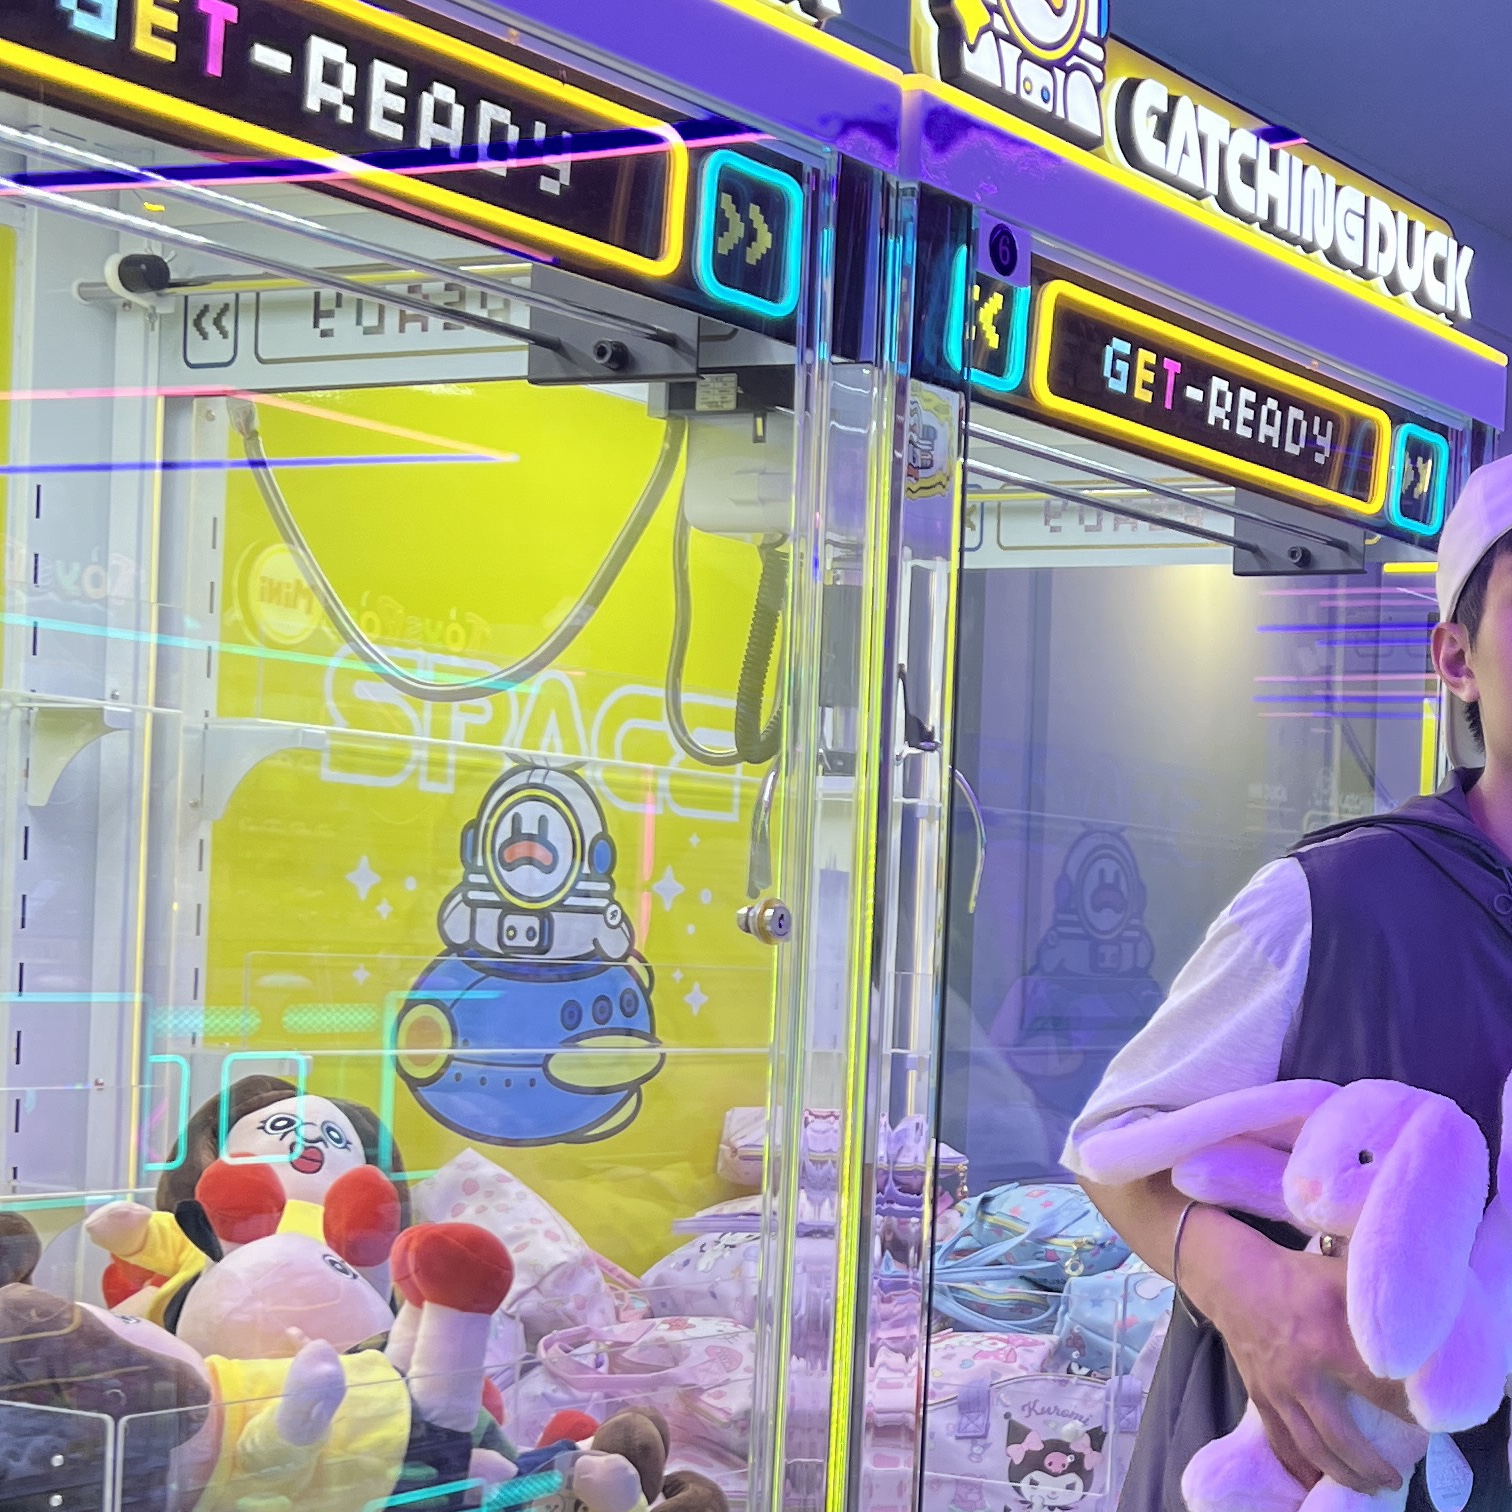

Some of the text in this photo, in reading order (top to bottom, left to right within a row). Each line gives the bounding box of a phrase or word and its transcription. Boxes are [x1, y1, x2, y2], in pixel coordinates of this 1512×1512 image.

[1131, 78, 1475, 320] CATCHINGDUCK
[1103, 336, 1334, 465] GET-READY
[1021, 1398, 1093, 1427] Kuromi
